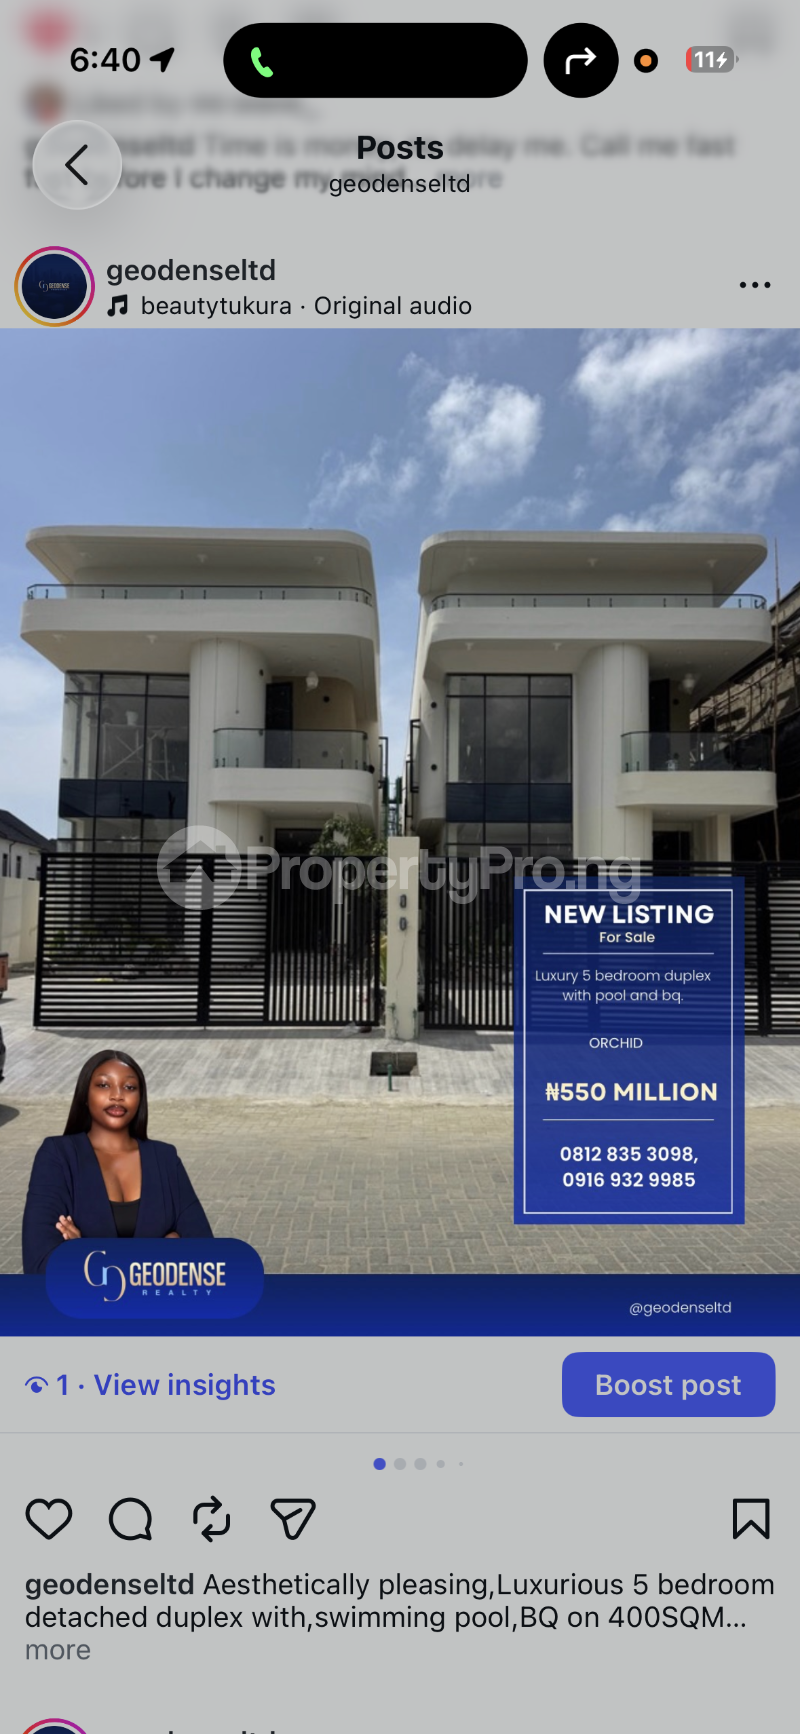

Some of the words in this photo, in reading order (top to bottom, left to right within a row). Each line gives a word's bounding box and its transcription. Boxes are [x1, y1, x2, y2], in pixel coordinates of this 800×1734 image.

[70, 47, 141, 73] 6:40
[694, 51, 714, 68] 11
[357, 136, 444, 160] Posts
[329, 173, 470, 197] geodenseltd
[106, 259, 276, 287] geodenseltd
[141, 296, 292, 320] beautytukura
[314, 296, 402, 320] Original
[410, 296, 472, 315] audio
[56, 1374, 68, 1396] 1
[94, 1373, 160, 1396] View
[168, 1373, 276, 1401] insights
[595, 1374, 673, 1396] Boost
[682, 1375, 742, 1401] post
[25, 1573, 194, 1601] geodenseltd
[203, 1573, 370, 1601] Aesthetically
[633, 1573, 648, 1596] 5
[658, 1573, 774, 1595] bedroom
[25, 1606, 148, 1628] detached
[156, 1606, 243, 1633] duplex
[567, 1611, 599, 1628] on
[25, 1643, 91, 1661] more
